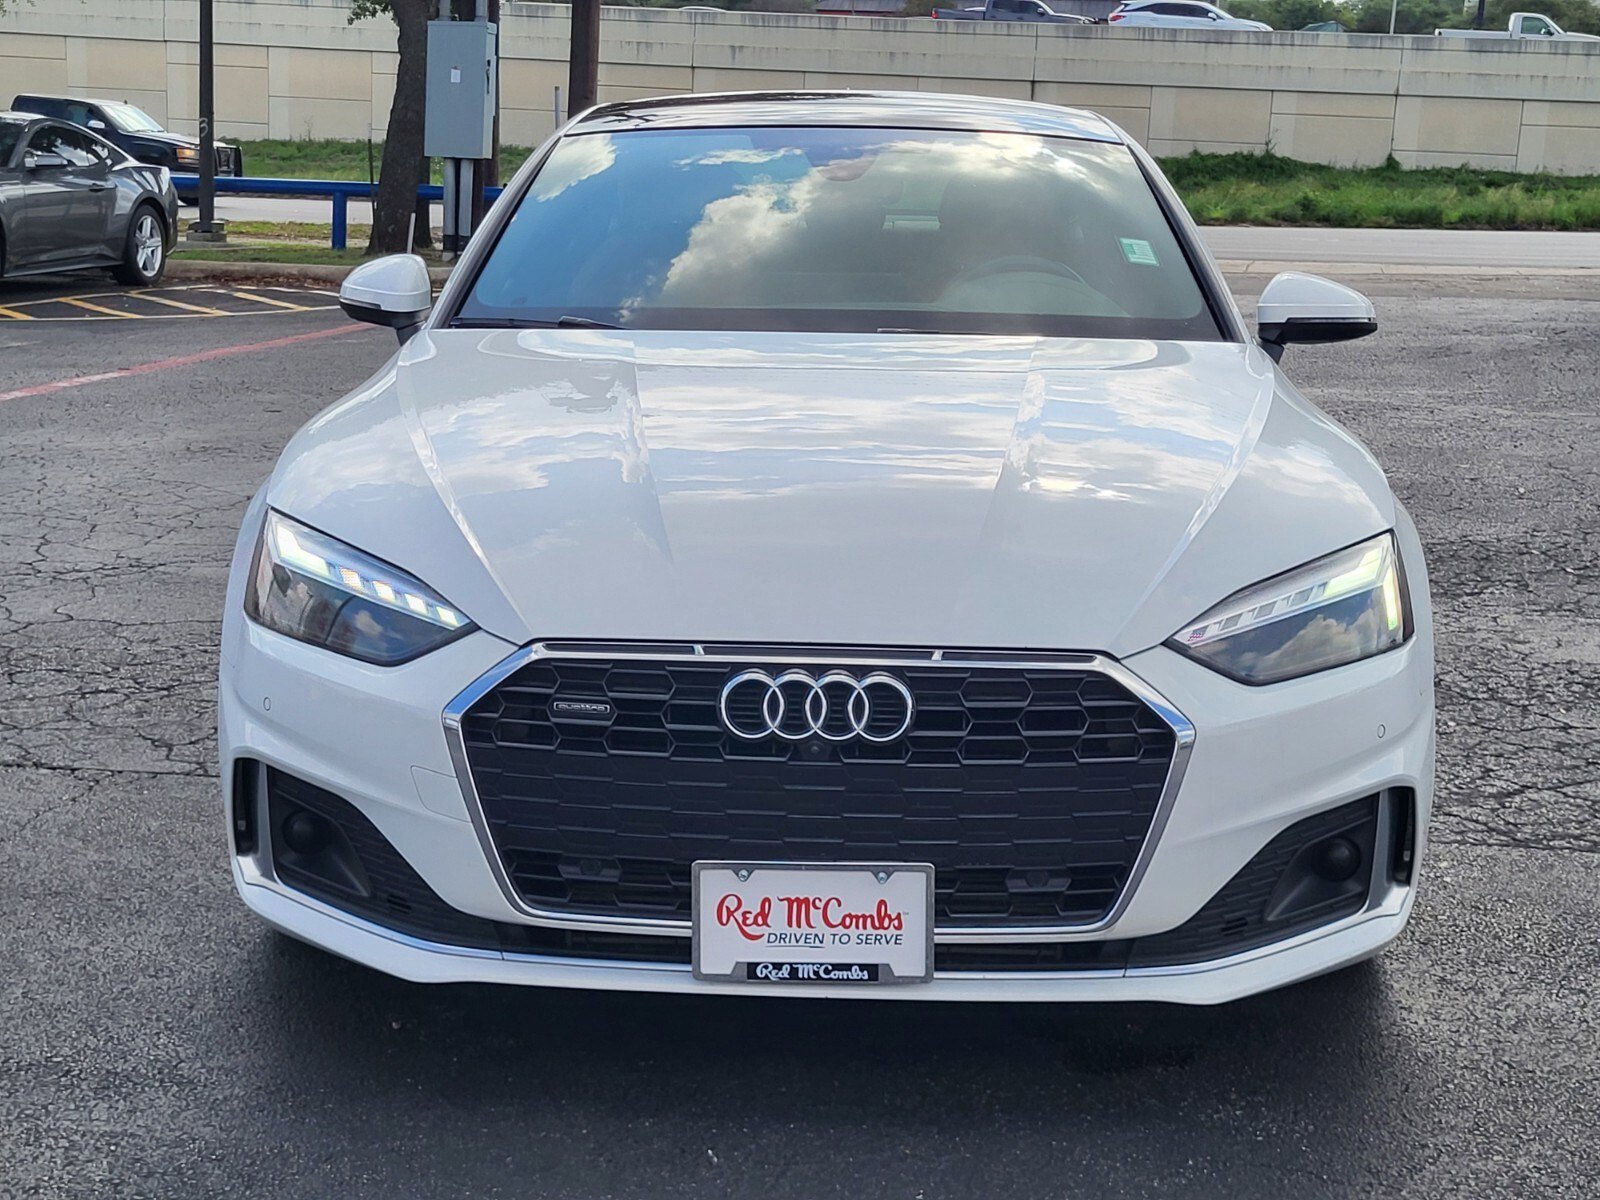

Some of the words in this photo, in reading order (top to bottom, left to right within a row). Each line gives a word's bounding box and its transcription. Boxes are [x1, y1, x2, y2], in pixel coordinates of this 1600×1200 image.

[716, 893, 772, 941] Red
[776, 896, 904, 931] McCombs
[766, 932, 825, 945] DRIVEN
[830, 932, 851, 945] TO
[855, 933, 904, 946] SERVE
[755, 962, 791, 981] Red
[792, 963, 869, 980] McCombs
